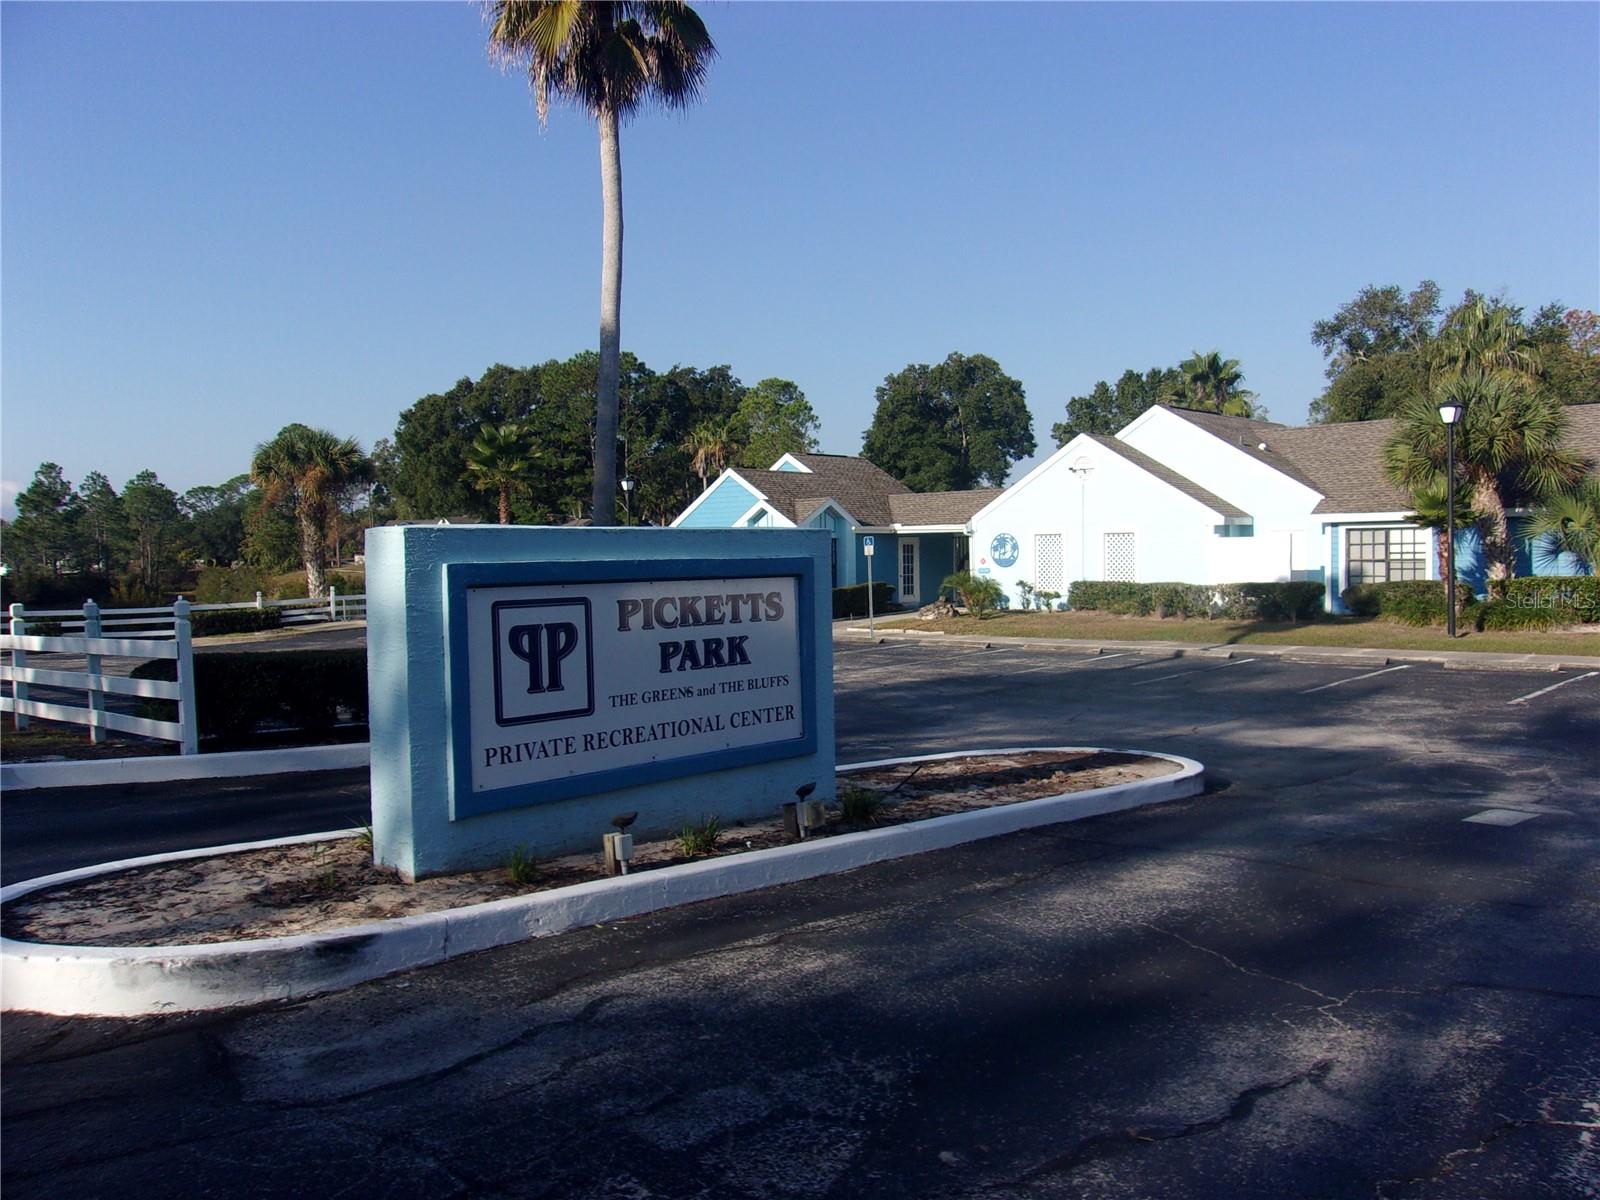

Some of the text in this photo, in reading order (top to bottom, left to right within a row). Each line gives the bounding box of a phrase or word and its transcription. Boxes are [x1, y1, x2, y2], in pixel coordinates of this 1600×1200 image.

[616, 592, 784, 631] PICKETTS
[659, 635, 752, 674] PARK
[608, 675, 789, 708] THE GREENS and THE BLUFFS
[484, 704, 796, 768] PRIVATE RECREATIONAL CENTER
